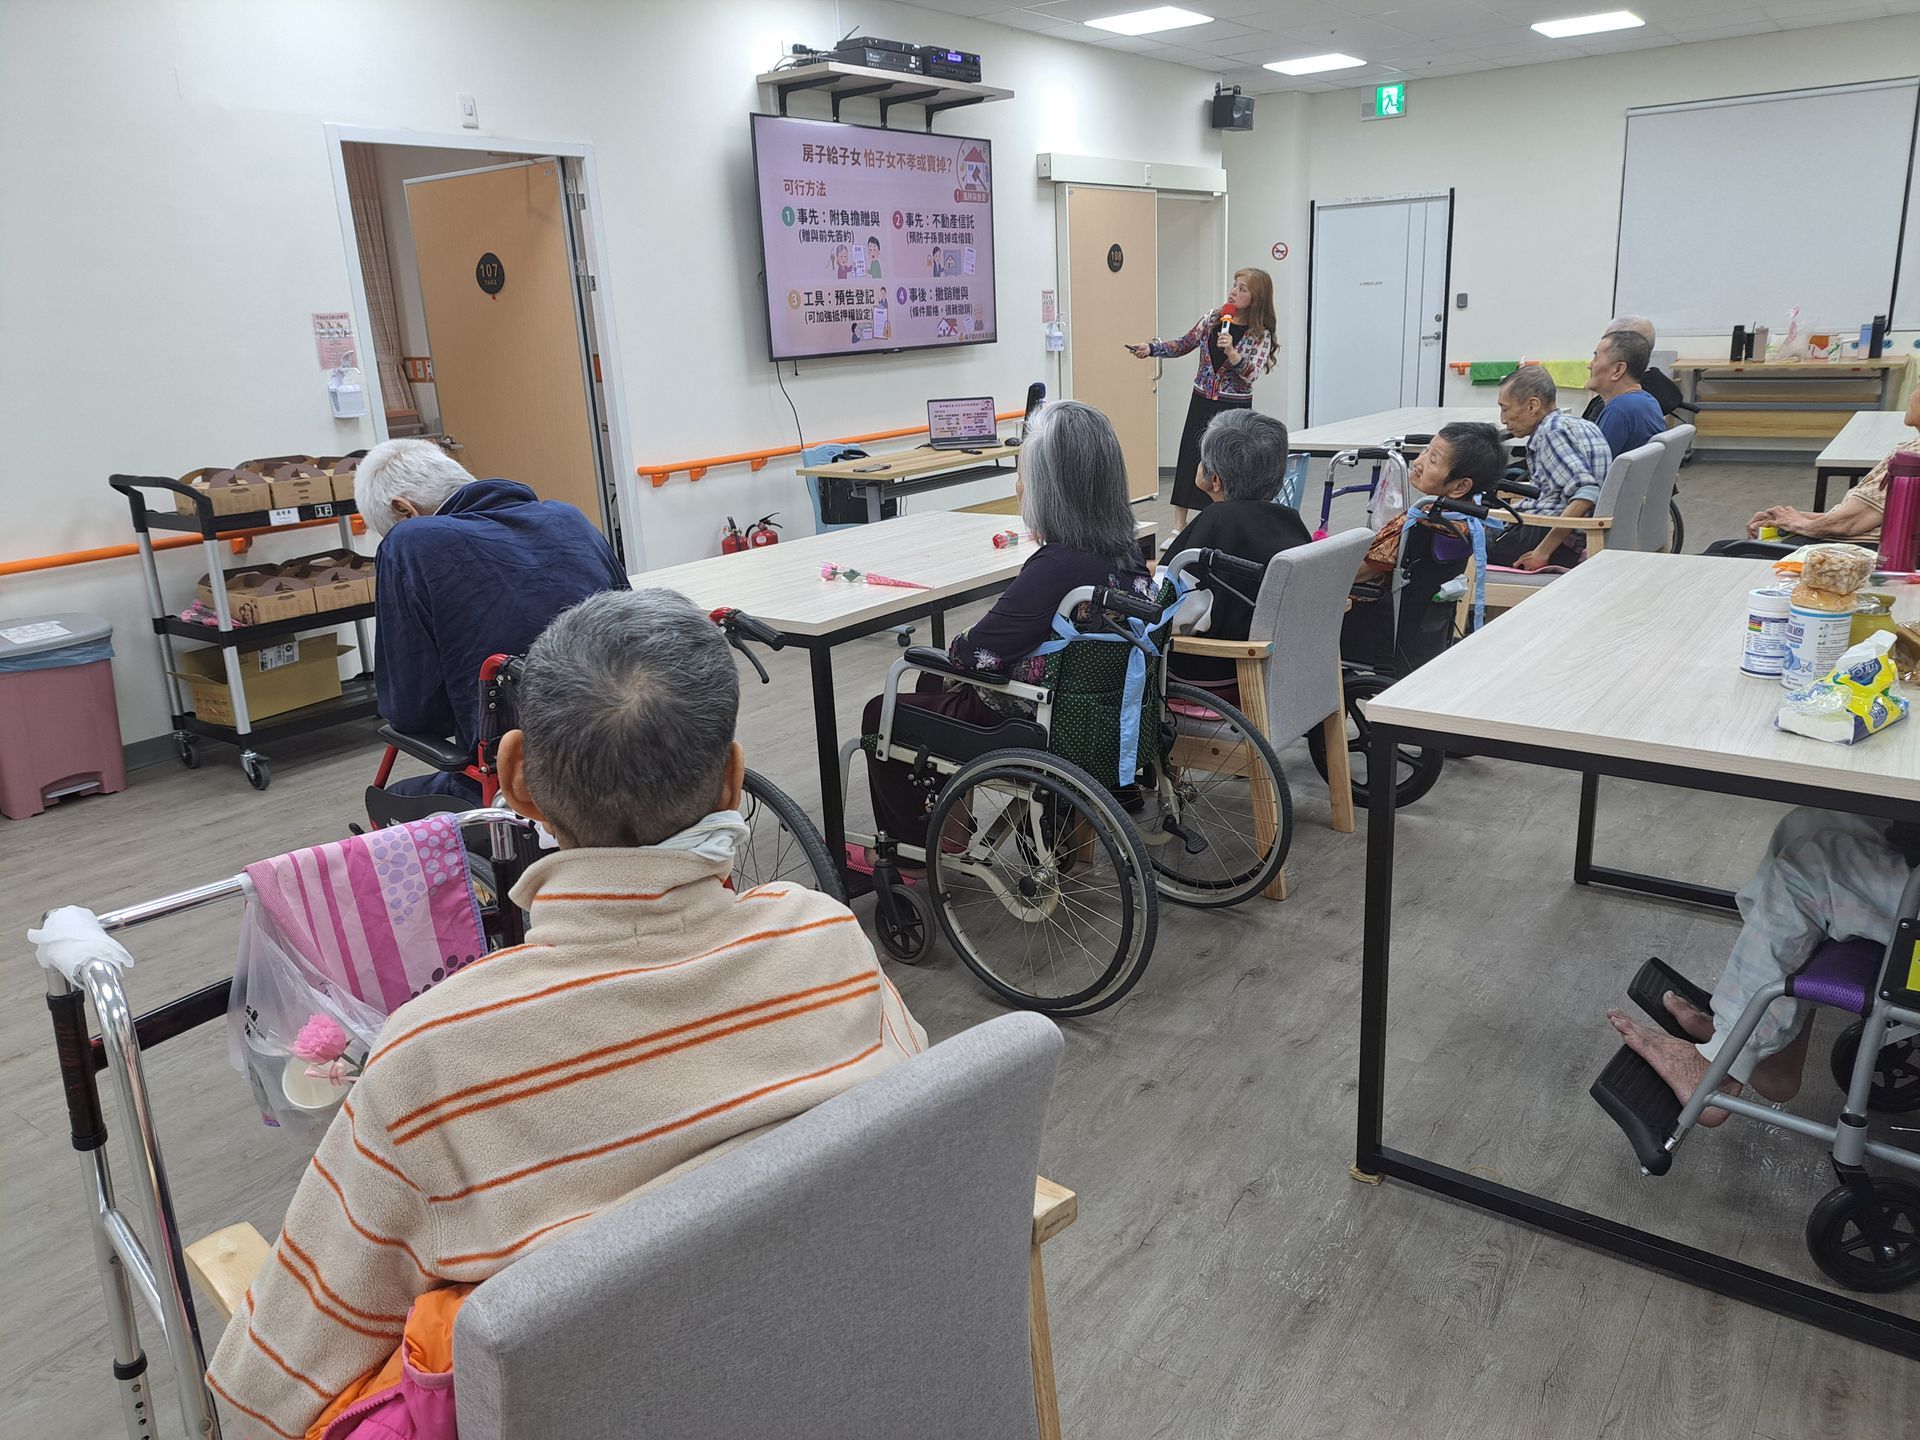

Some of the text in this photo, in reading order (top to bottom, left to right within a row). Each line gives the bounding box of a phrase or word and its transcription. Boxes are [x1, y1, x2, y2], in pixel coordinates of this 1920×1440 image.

[802, 144, 861, 167] 房子給子女
[783, 179, 827, 197] 可行方法
[480, 263, 498, 278] 107
